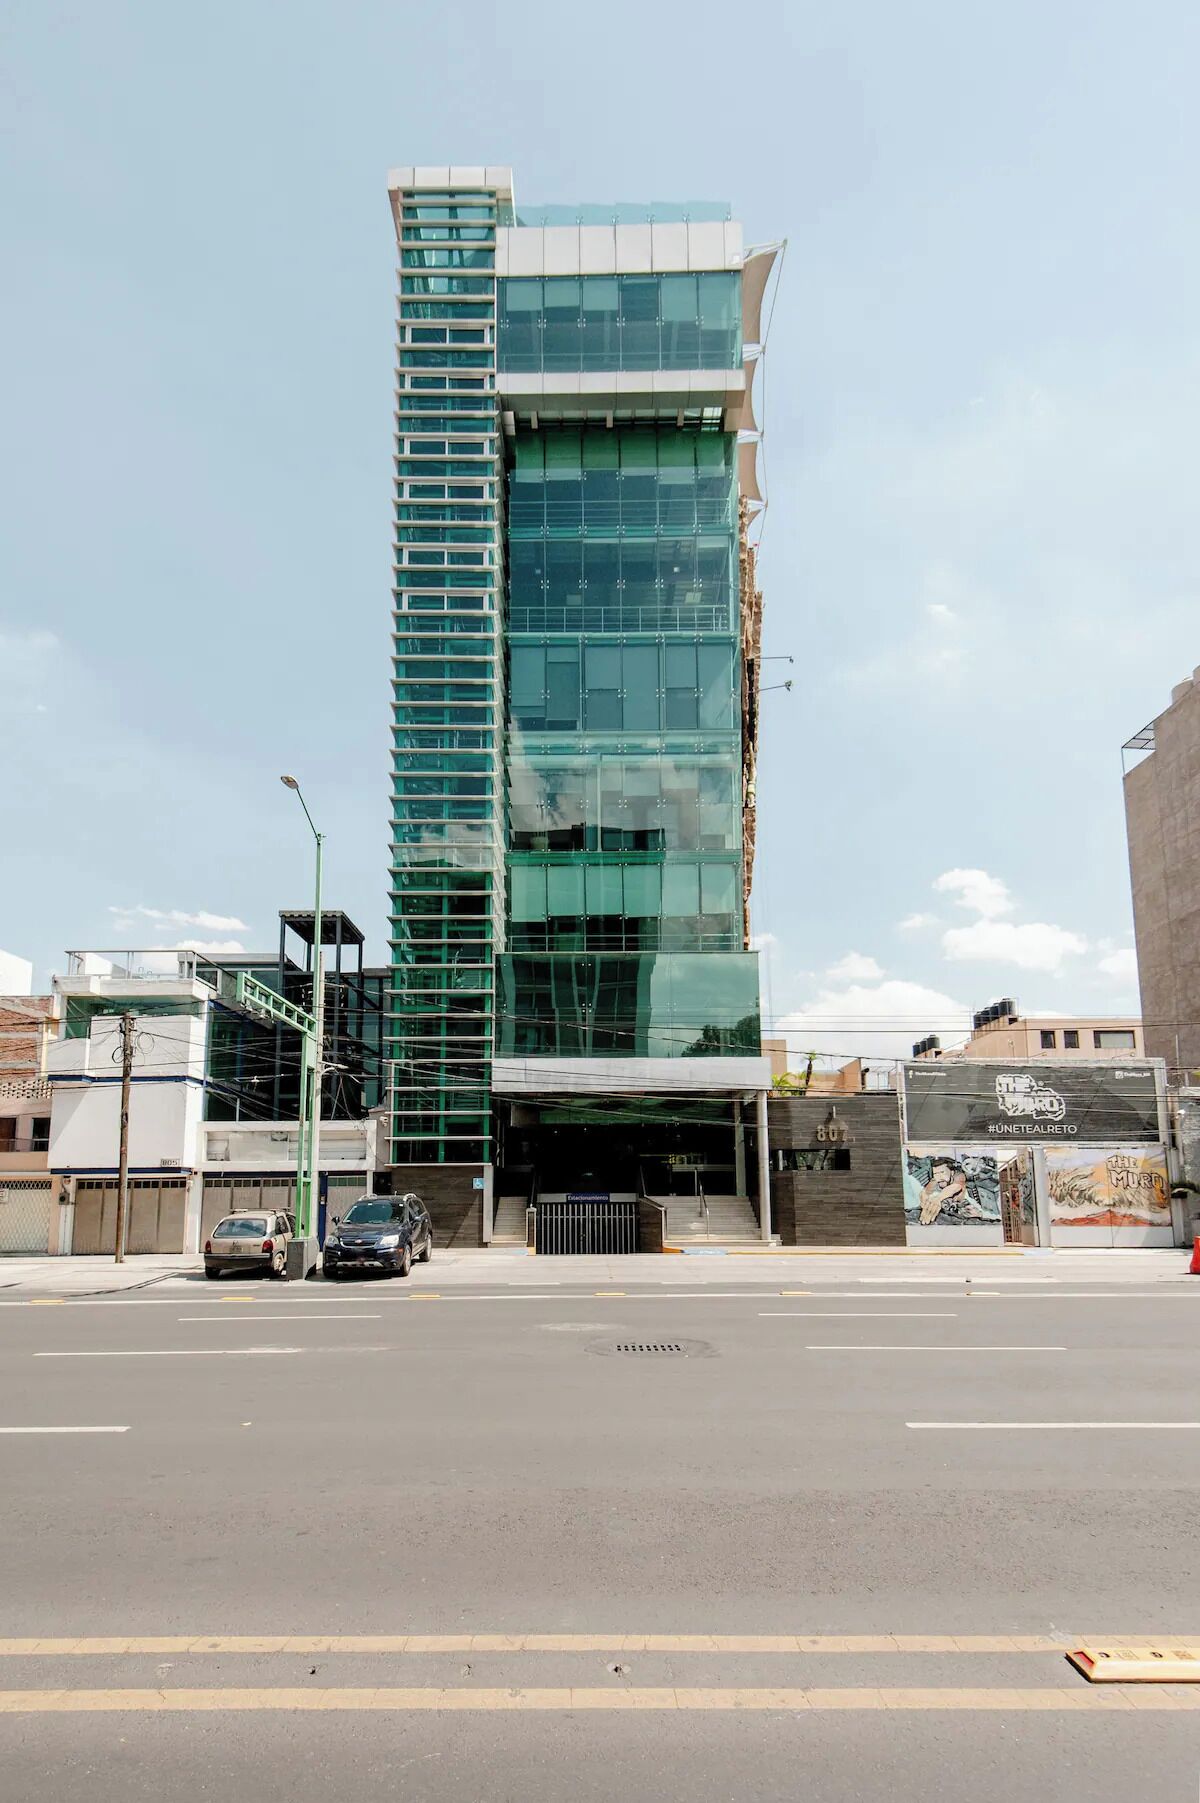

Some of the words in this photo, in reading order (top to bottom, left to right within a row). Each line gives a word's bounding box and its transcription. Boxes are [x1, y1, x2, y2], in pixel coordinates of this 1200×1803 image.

[998, 1077, 1031, 1093] THE
[988, 1122, 1077, 1134] #ÚNETEALRETO
[1107, 1155, 1138, 1169] THE
